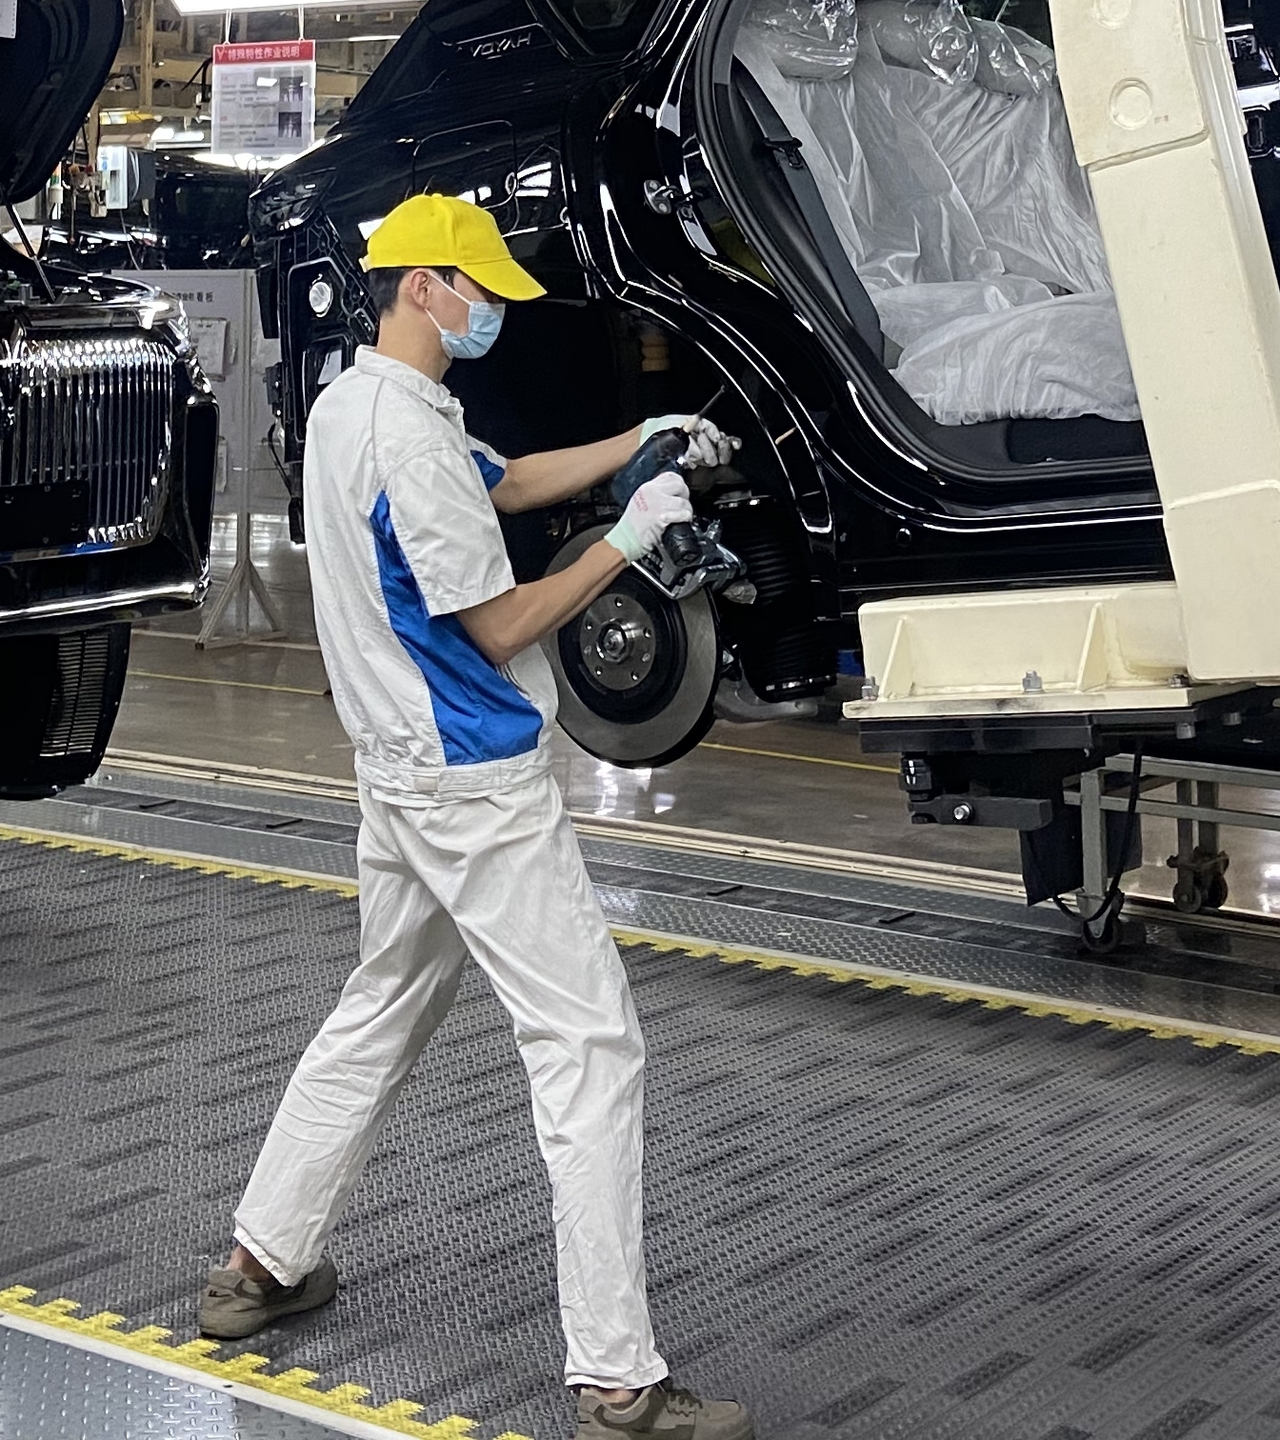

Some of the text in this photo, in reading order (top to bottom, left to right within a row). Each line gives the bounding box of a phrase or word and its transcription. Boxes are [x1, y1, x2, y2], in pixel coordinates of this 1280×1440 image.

[227, 45, 300, 62] 特殊特性作业说明
[472, 32, 532, 57] VOYAH
